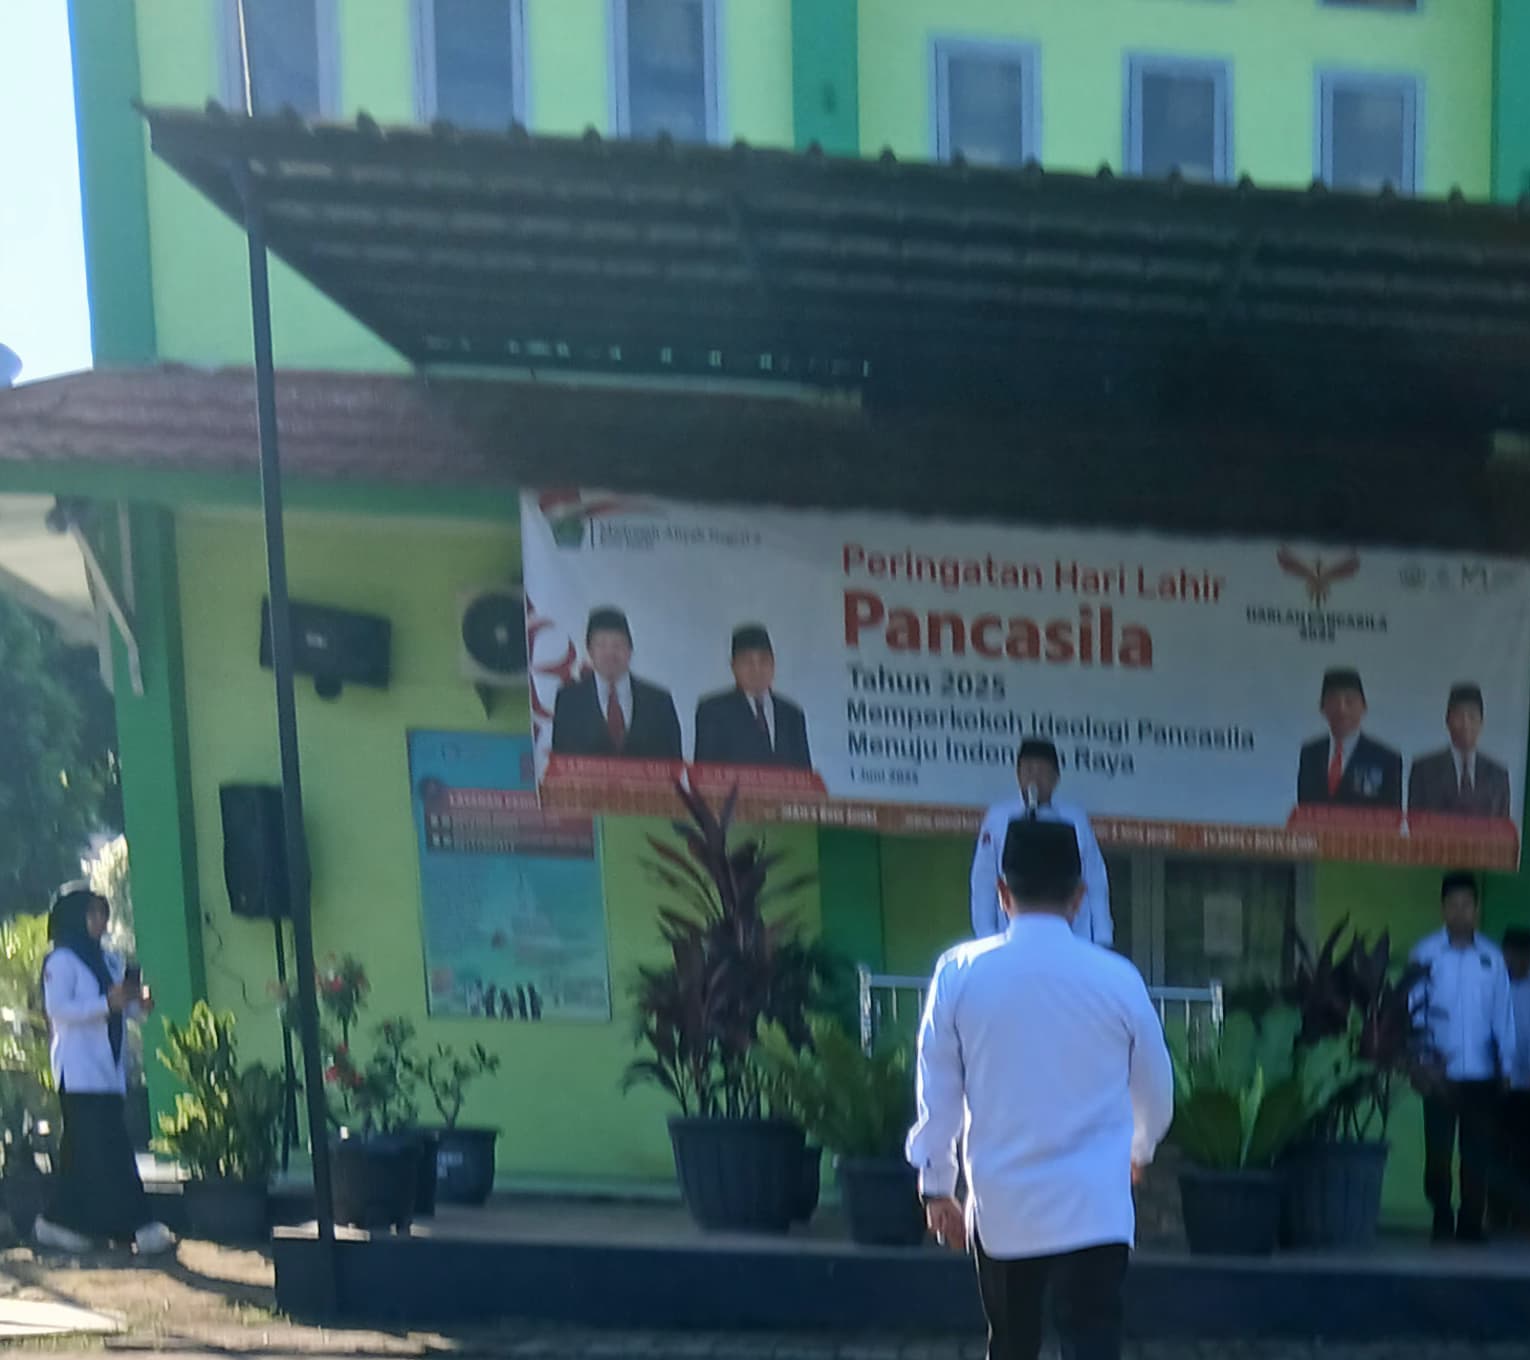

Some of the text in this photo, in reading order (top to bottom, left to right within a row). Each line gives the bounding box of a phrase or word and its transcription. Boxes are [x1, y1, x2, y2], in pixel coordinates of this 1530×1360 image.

[843, 543, 1226, 604] Peringatan Hari Lahir
[844, 589, 1153, 669] Pancasila
[848, 663, 1006, 701] Tahun 2025
[847, 698, 1255, 752] Memperkokoh Ideologi Pancasila
[847, 731, 1135, 779] Menuju Indona Raya
